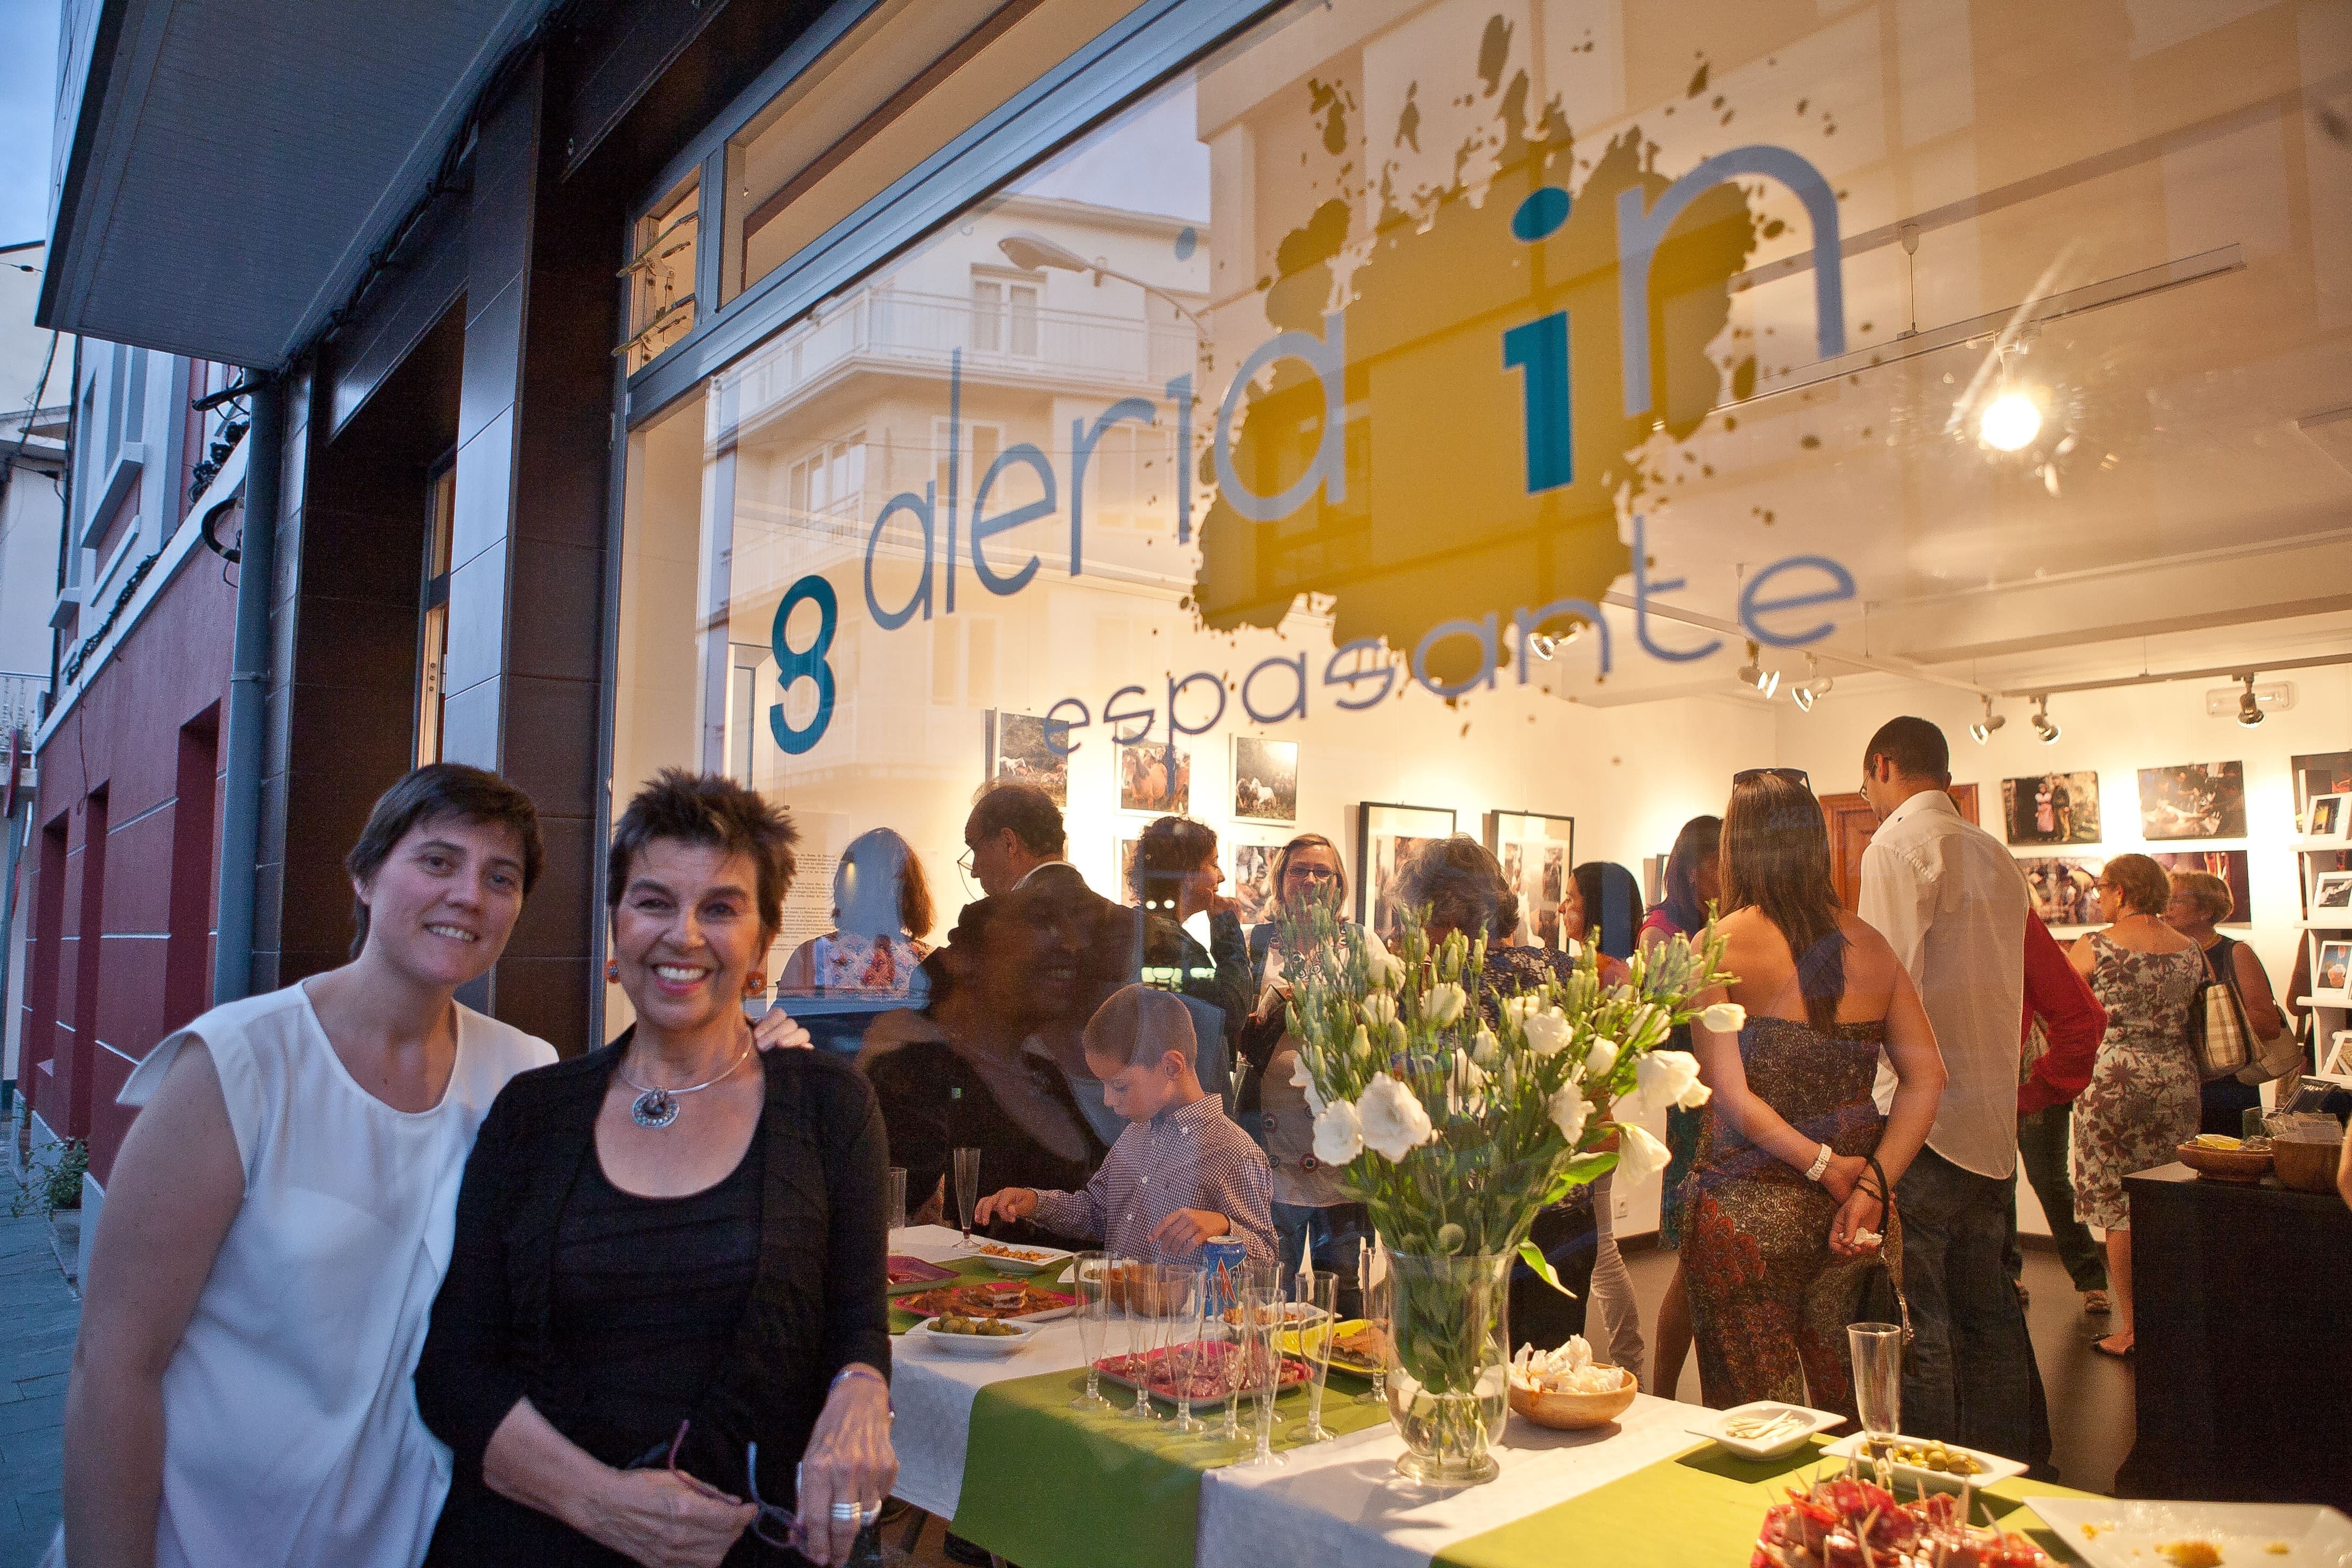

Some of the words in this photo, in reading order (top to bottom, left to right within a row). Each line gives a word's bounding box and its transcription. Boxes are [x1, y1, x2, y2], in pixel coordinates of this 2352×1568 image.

[770, 226, 1346, 754] galeria
[1503, 144, 1846, 495] in
[1043, 515, 1857, 796] espasante
